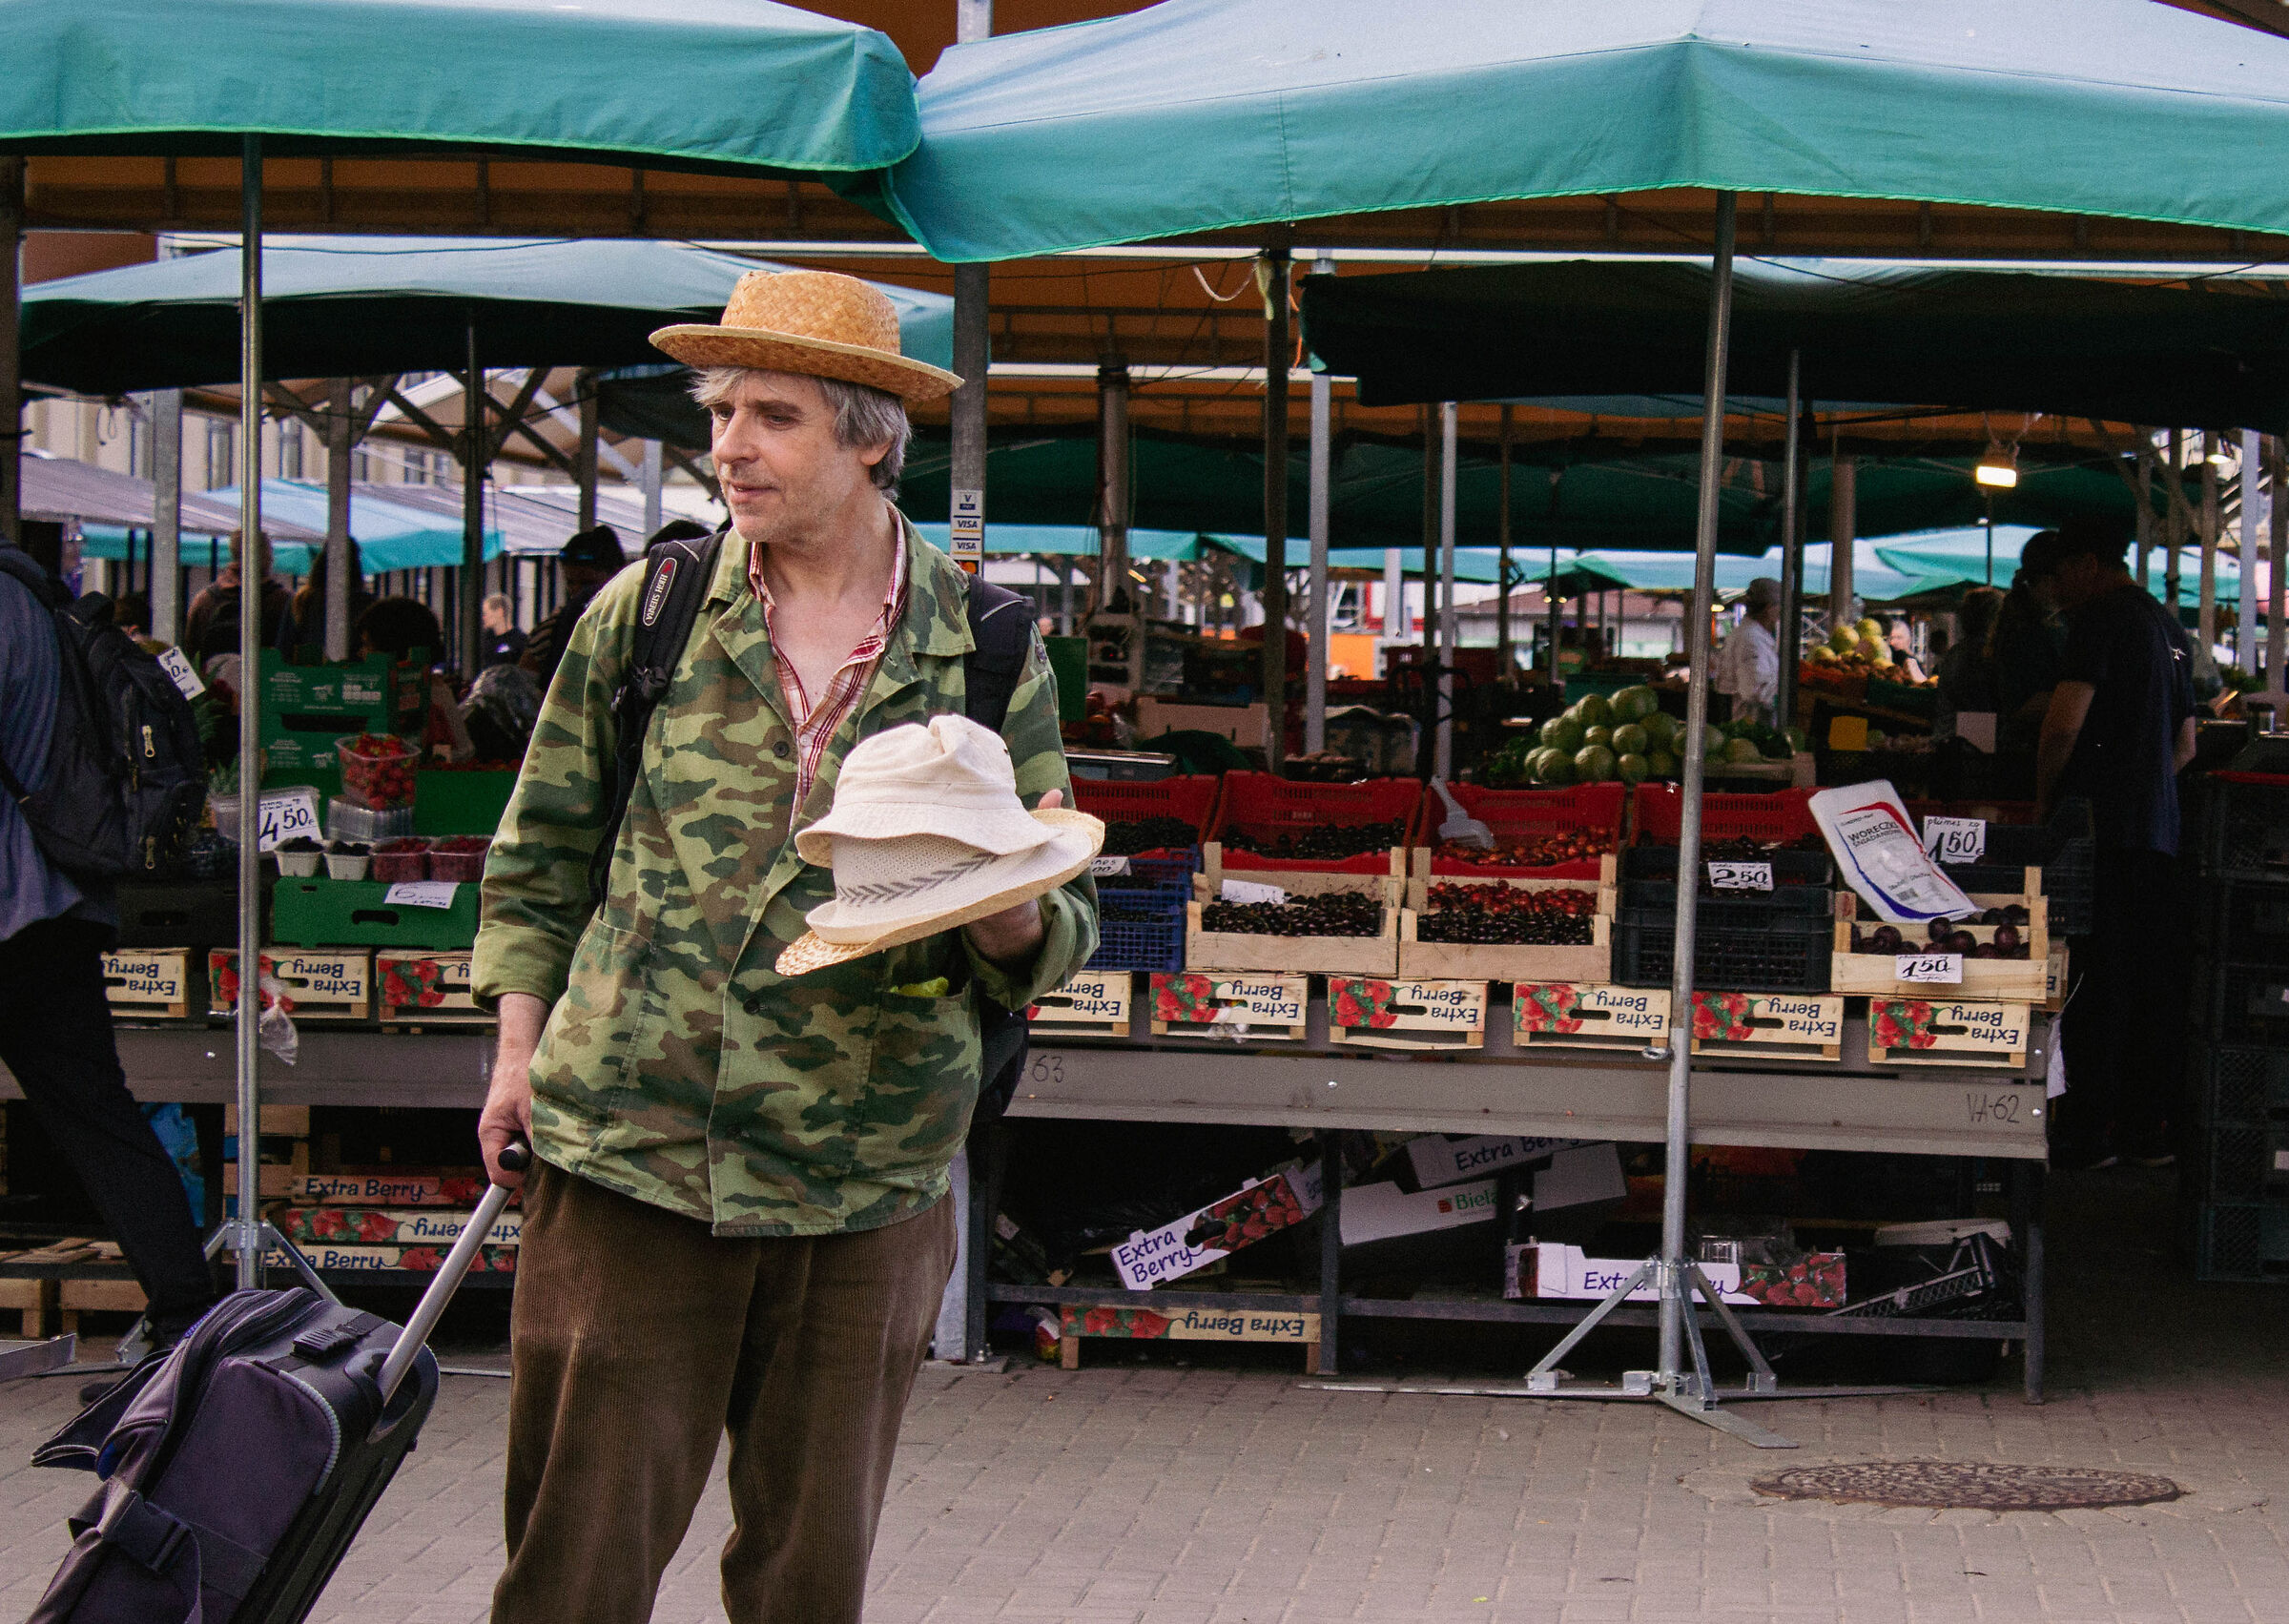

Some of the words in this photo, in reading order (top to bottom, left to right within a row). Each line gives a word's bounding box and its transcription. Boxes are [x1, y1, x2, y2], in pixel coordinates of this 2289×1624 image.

[957, 520, 978, 528] VISA
[957, 542, 977, 550] VISA
[654, 573, 669, 593] HIGH
[645, 593, 661, 621] SIERRA
[108, 957, 159, 978] Berry
[293, 958, 344, 978] Berry
[129, 979, 175, 996] Extra
[314, 979, 361, 997] Extra
[1231, 979, 1283, 1000] Berry
[1411, 984, 1463, 1005] Berry
[1074, 999, 1122, 1016] Extra
[1251, 1001, 1299, 1018] Extra
[1597, 990, 1648, 1012] Berry
[1768, 997, 1821, 1018] Berry
[1431, 1007, 1478, 1023] Extra
[1617, 1013, 1663, 1030] Extra
[1951, 1005, 2004, 1026] Berry
[1788, 1019, 1837, 1037] Extra
[1971, 1028, 2019, 1044] Extra
[1454, 1143, 1515, 1171] Extra
[305, 1177, 359, 1197] Extra
[365, 1179, 424, 1202] Berry
[491, 1224, 521, 1242] xtr
[1118, 1229, 1177, 1266] Extra
[264, 1250, 317, 1269] Exa
[323, 1250, 383, 1270] Berry
[1131, 1246, 1193, 1283] Berry
[1583, 1271, 1647, 1291] Ext
[1185, 1310, 1244, 1335] Berry
[1250, 1318, 1305, 1337] Extra
